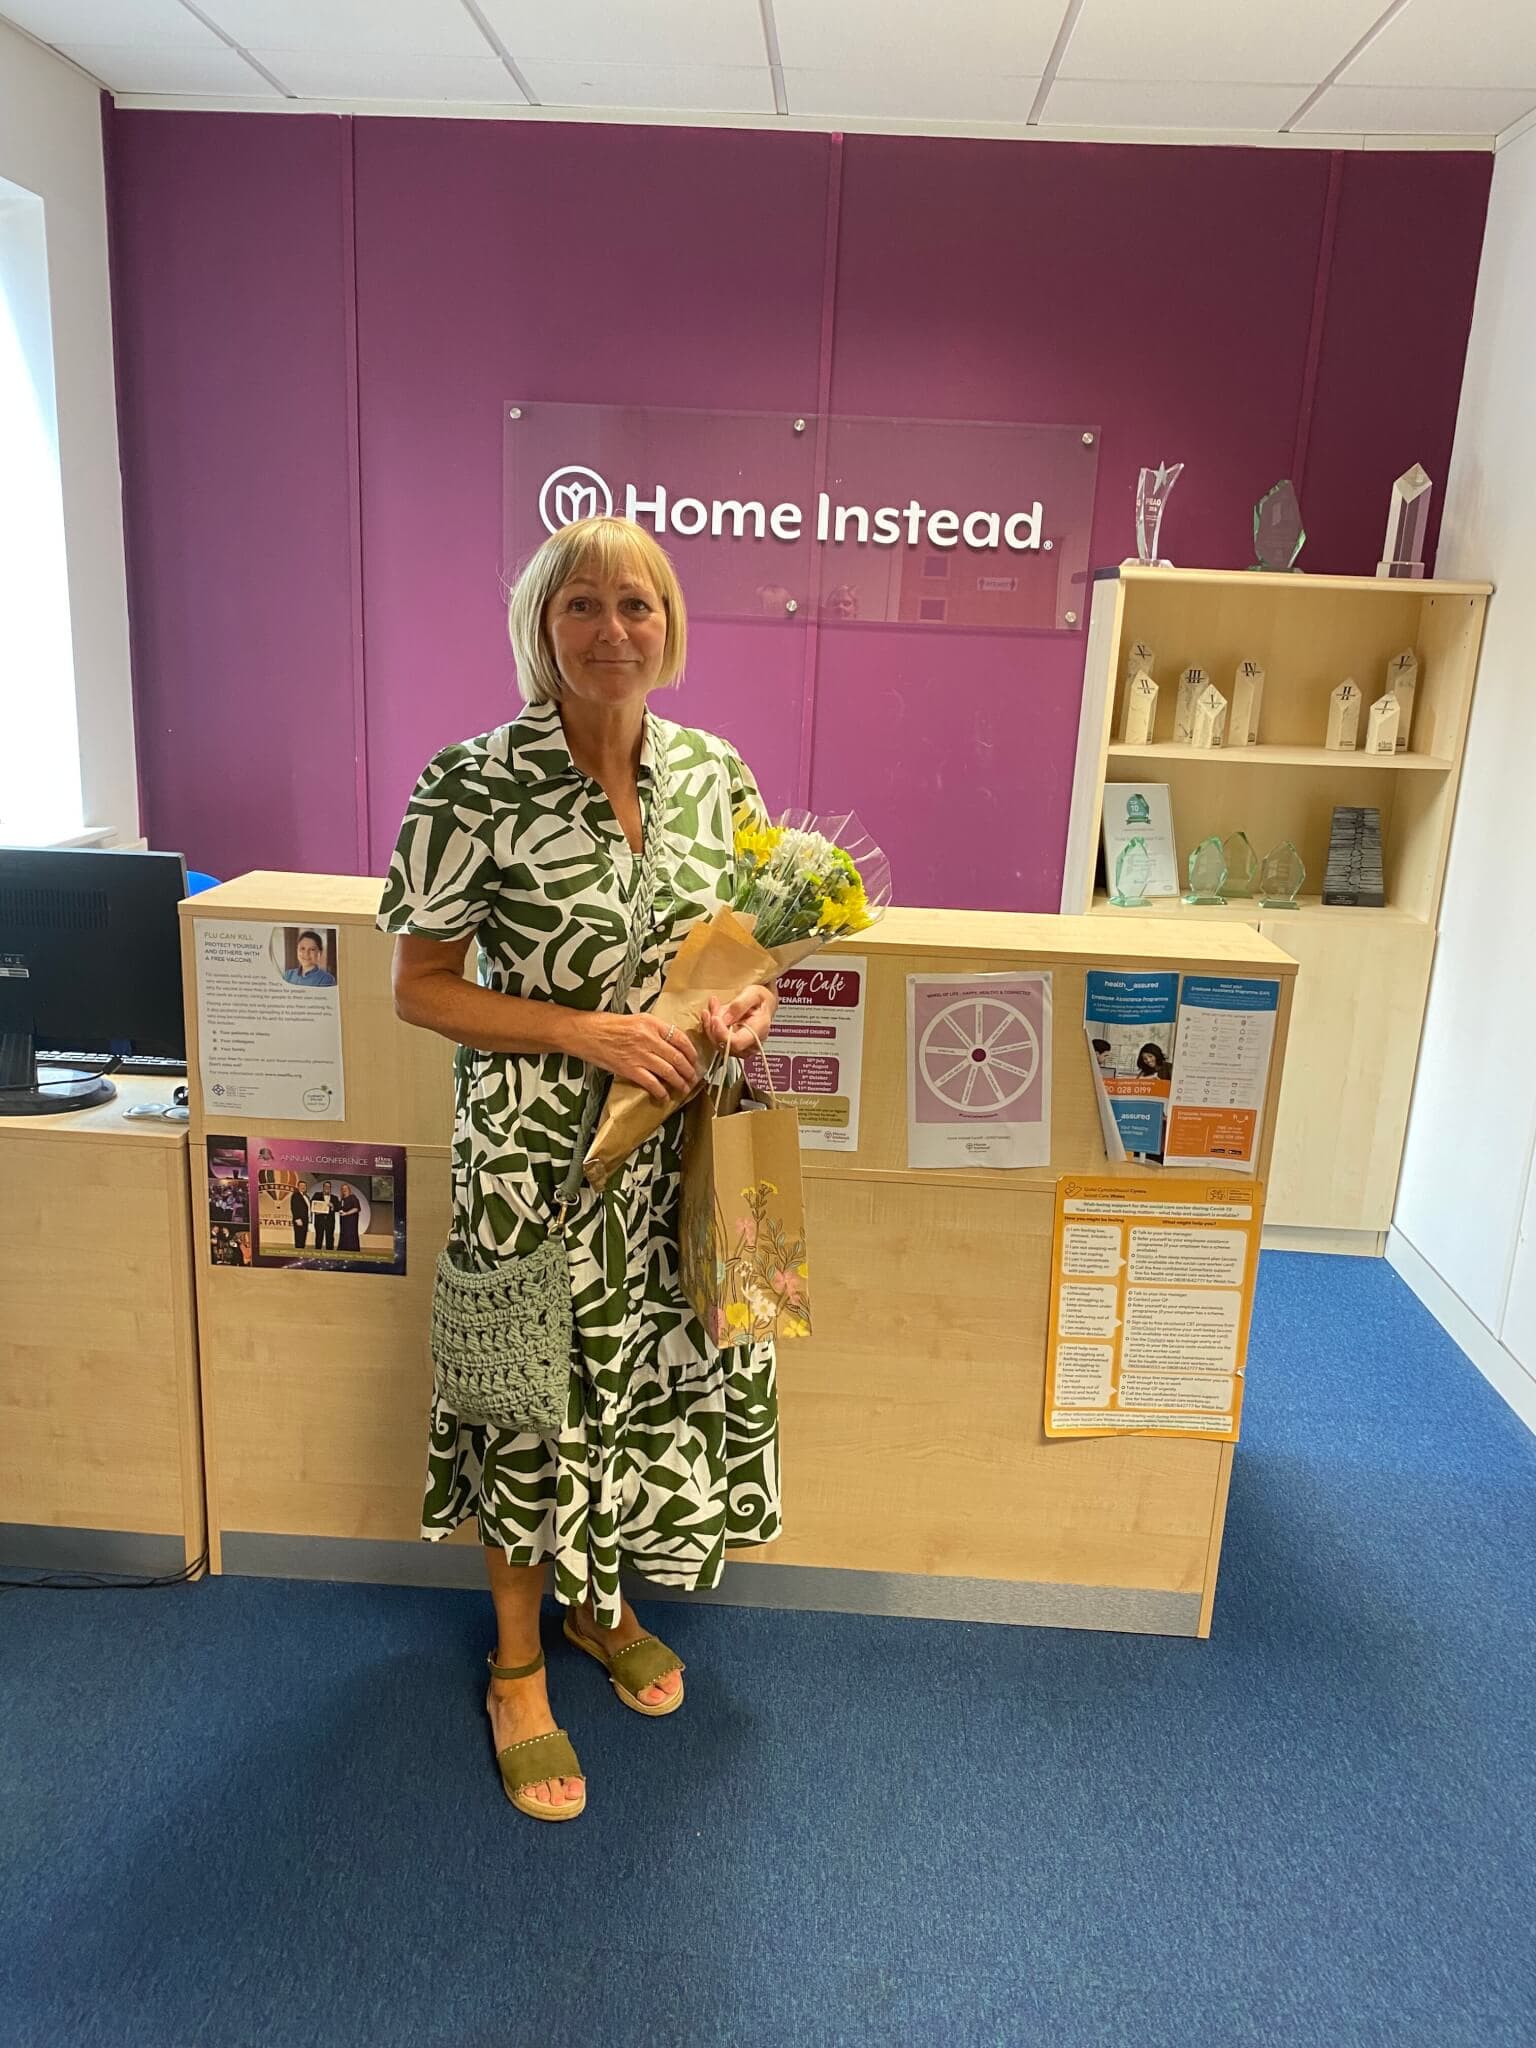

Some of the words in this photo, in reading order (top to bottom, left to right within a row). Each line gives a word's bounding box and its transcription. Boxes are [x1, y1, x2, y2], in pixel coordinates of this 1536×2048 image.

[625, 484, 801, 541] Home
[809, 972, 846, 1001] Café
[1134, 1086, 1152, 1094] 0199
[280, 1155, 314, 1163] ANNUAL
[316, 1156, 368, 1166] CONFERENCE
